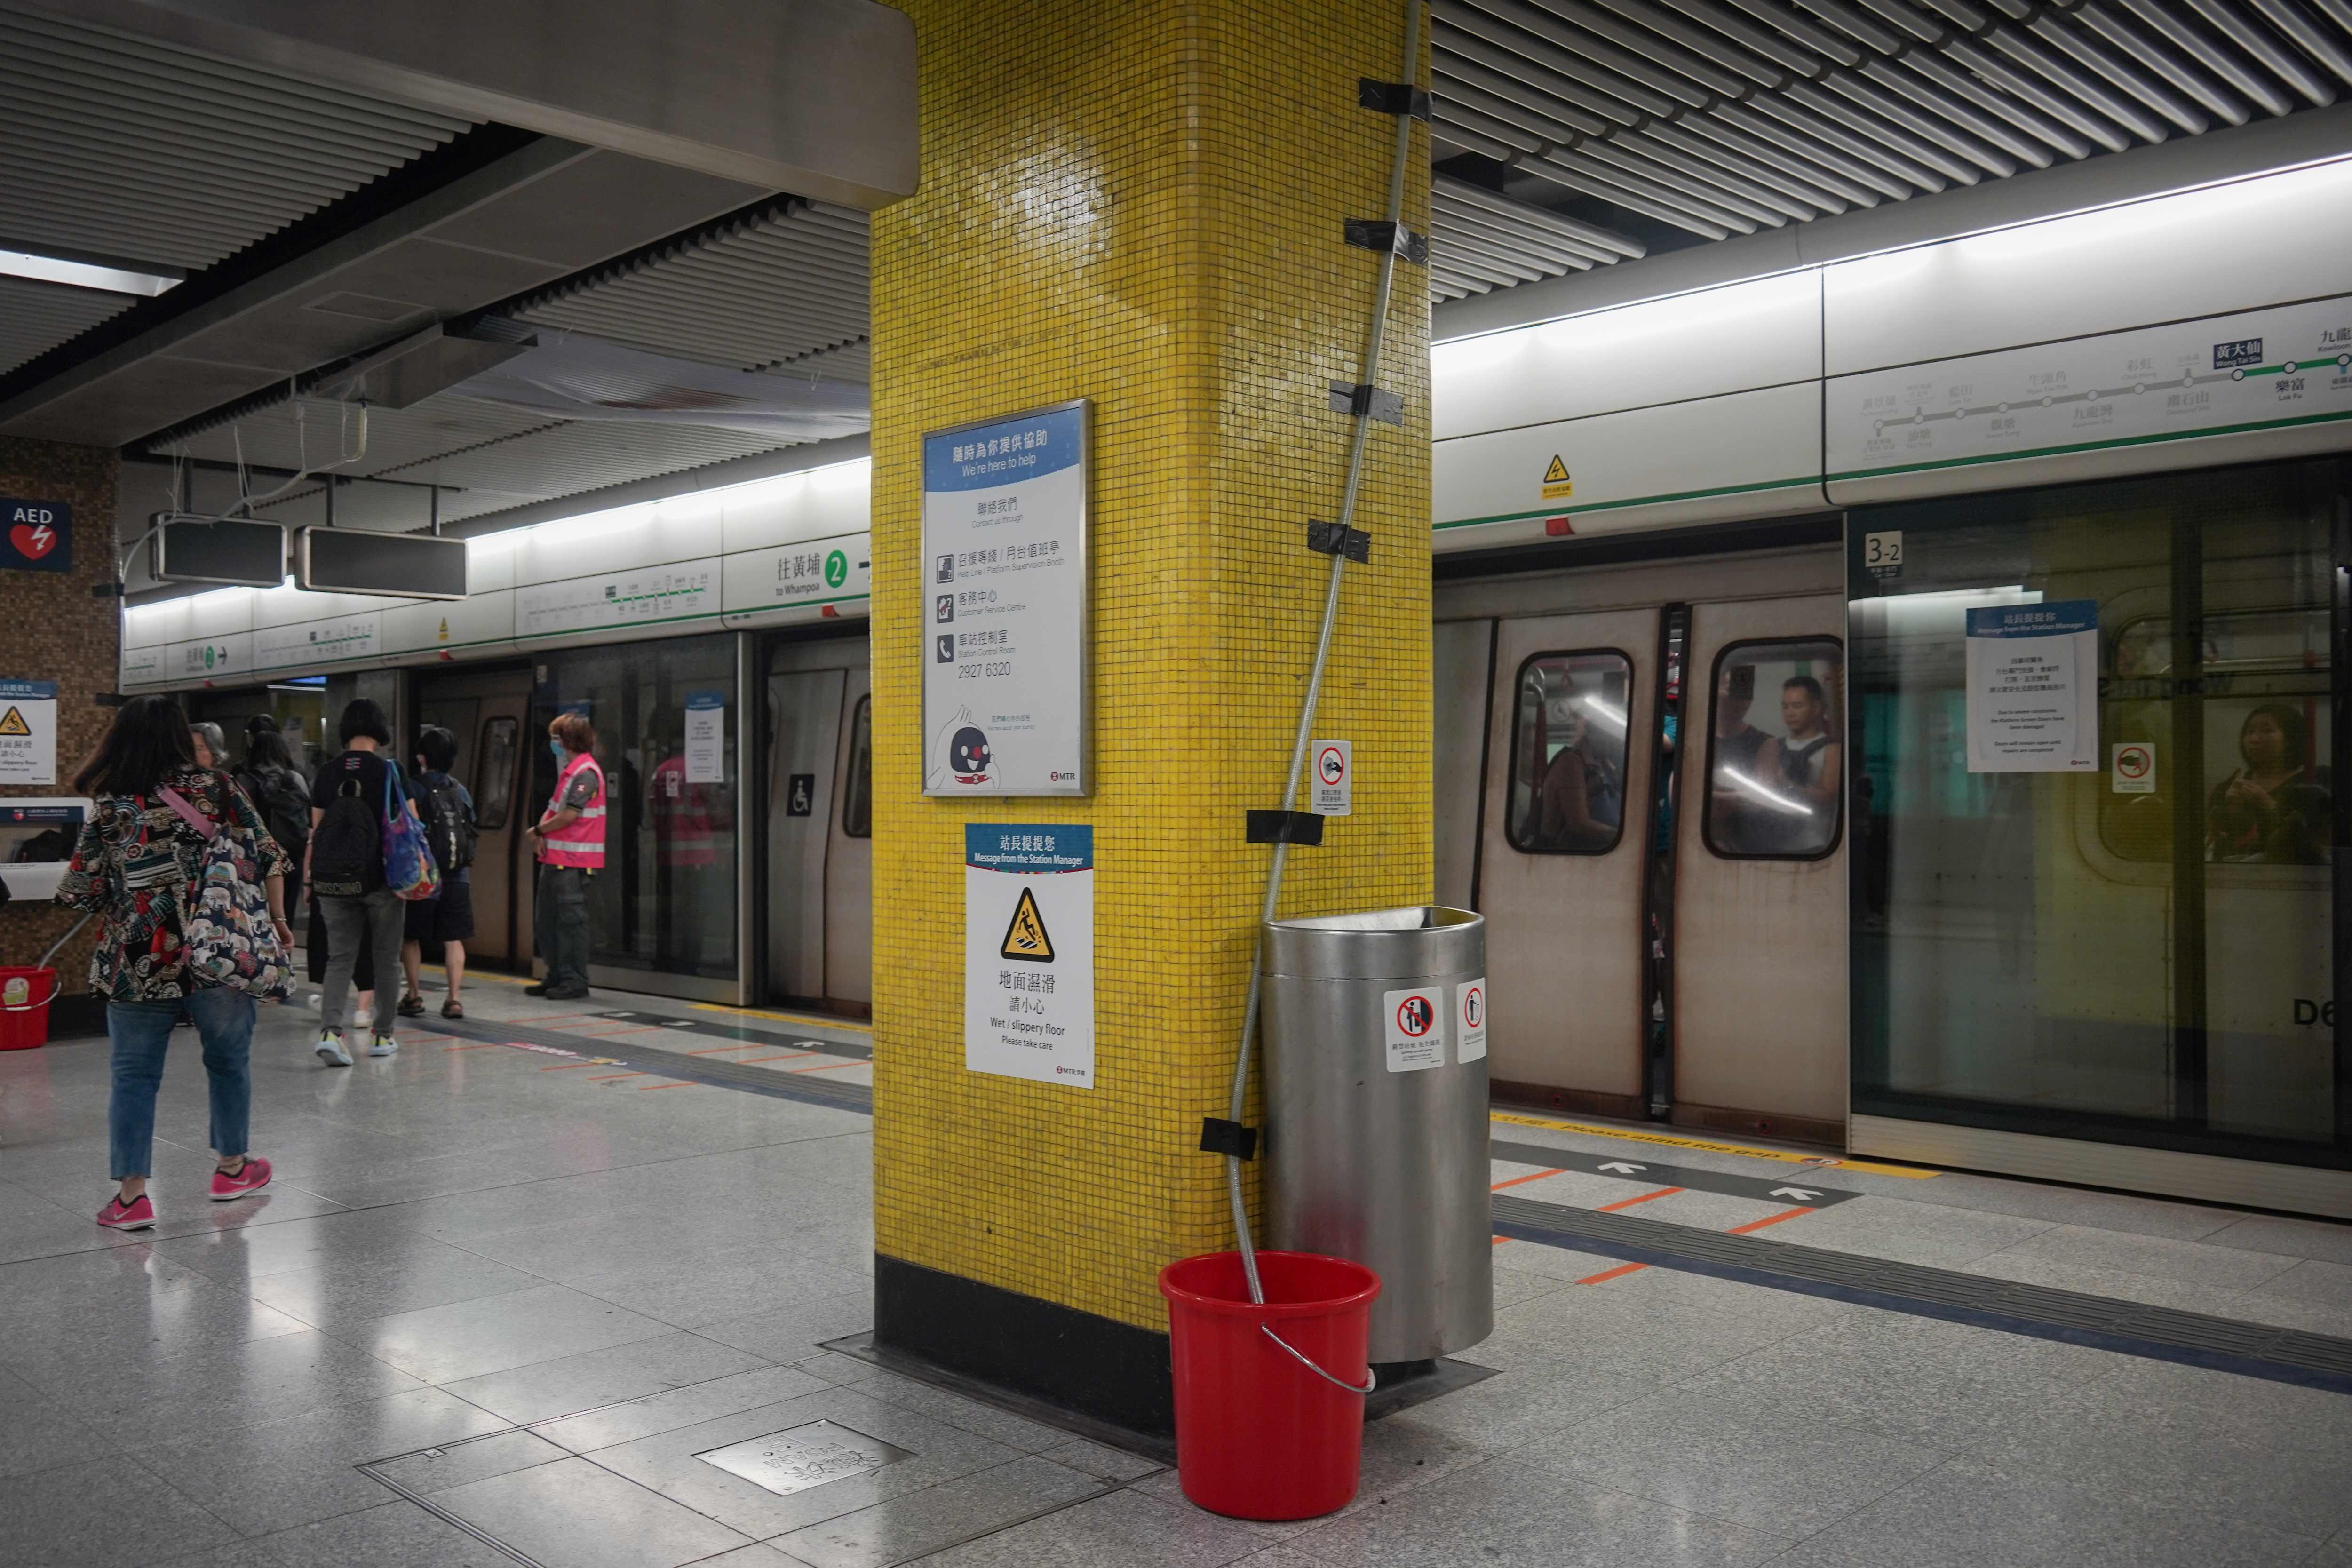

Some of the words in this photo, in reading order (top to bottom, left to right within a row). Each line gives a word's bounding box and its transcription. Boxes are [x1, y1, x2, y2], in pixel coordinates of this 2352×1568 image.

[2216, 341, 2261, 359] 黃大仙
[2216, 359, 2236, 367] Wong
[2275, 378, 2305, 393] 樂富
[953, 429, 1048, 463] 隨時為你提供協助
[962, 462, 987, 477] We're
[988, 459, 1007, 473] here
[1008, 458, 1017, 468] to
[1018, 453, 1036, 467] help
[14, 508, 53, 524] AED
[977, 497, 1017, 517] 聯絡我們
[972, 518, 993, 528] Contact
[1002, 514, 1023, 524] through
[1007, 541, 1060, 561] 月台值班亭
[1869, 538, 1900, 563] 3-2
[778, 552, 820, 581] 往黃埔
[831, 557, 841, 581] 2
[958, 569, 969, 579] Help
[970, 568, 983, 576] Line
[987, 565, 1010, 574] Platform
[1012, 561, 1046, 572] Supervision
[1047, 557, 1065, 566] Booth
[776, 587, 783, 596] to
[785, 583, 820, 595] Whampoa
[958, 589, 997, 606] 客務中心
[1007, 603, 1026, 612] Centre
[959, 629, 1008, 646] 車站控制室
[977, 648, 997, 656] Control
[958, 664, 982, 679] 2927
[985, 661, 1011, 677] 6320
[1000, 835, 1055, 852] 站長提提您
[974, 852, 1001, 864] Message
[1001, 853, 1016, 863] from
[1017, 853, 1029, 863] the
[1029, 854, 1052, 865] Station
[1053, 855, 1083, 867] Manager
[999, 970, 1056, 994] 地面濕滑
[1009, 996, 1045, 1015] 請小心
[990, 1016, 1006, 1029] Wet
[1012, 1019, 1044, 1035] slippery
[1045, 1022, 1065, 1036] floor
[1001, 1035, 1022, 1047] Please
[1023, 1038, 1038, 1048] take
[1038, 1041, 1053, 1051] care
[1560, 1125, 1629, 1138] Please
[1630, 1135, 1692, 1146] mind
[1692, 1143, 1731, 1151] the
[1734, 1149, 1781, 1158] gap
[764, 1442, 846, 1468] FOAM
